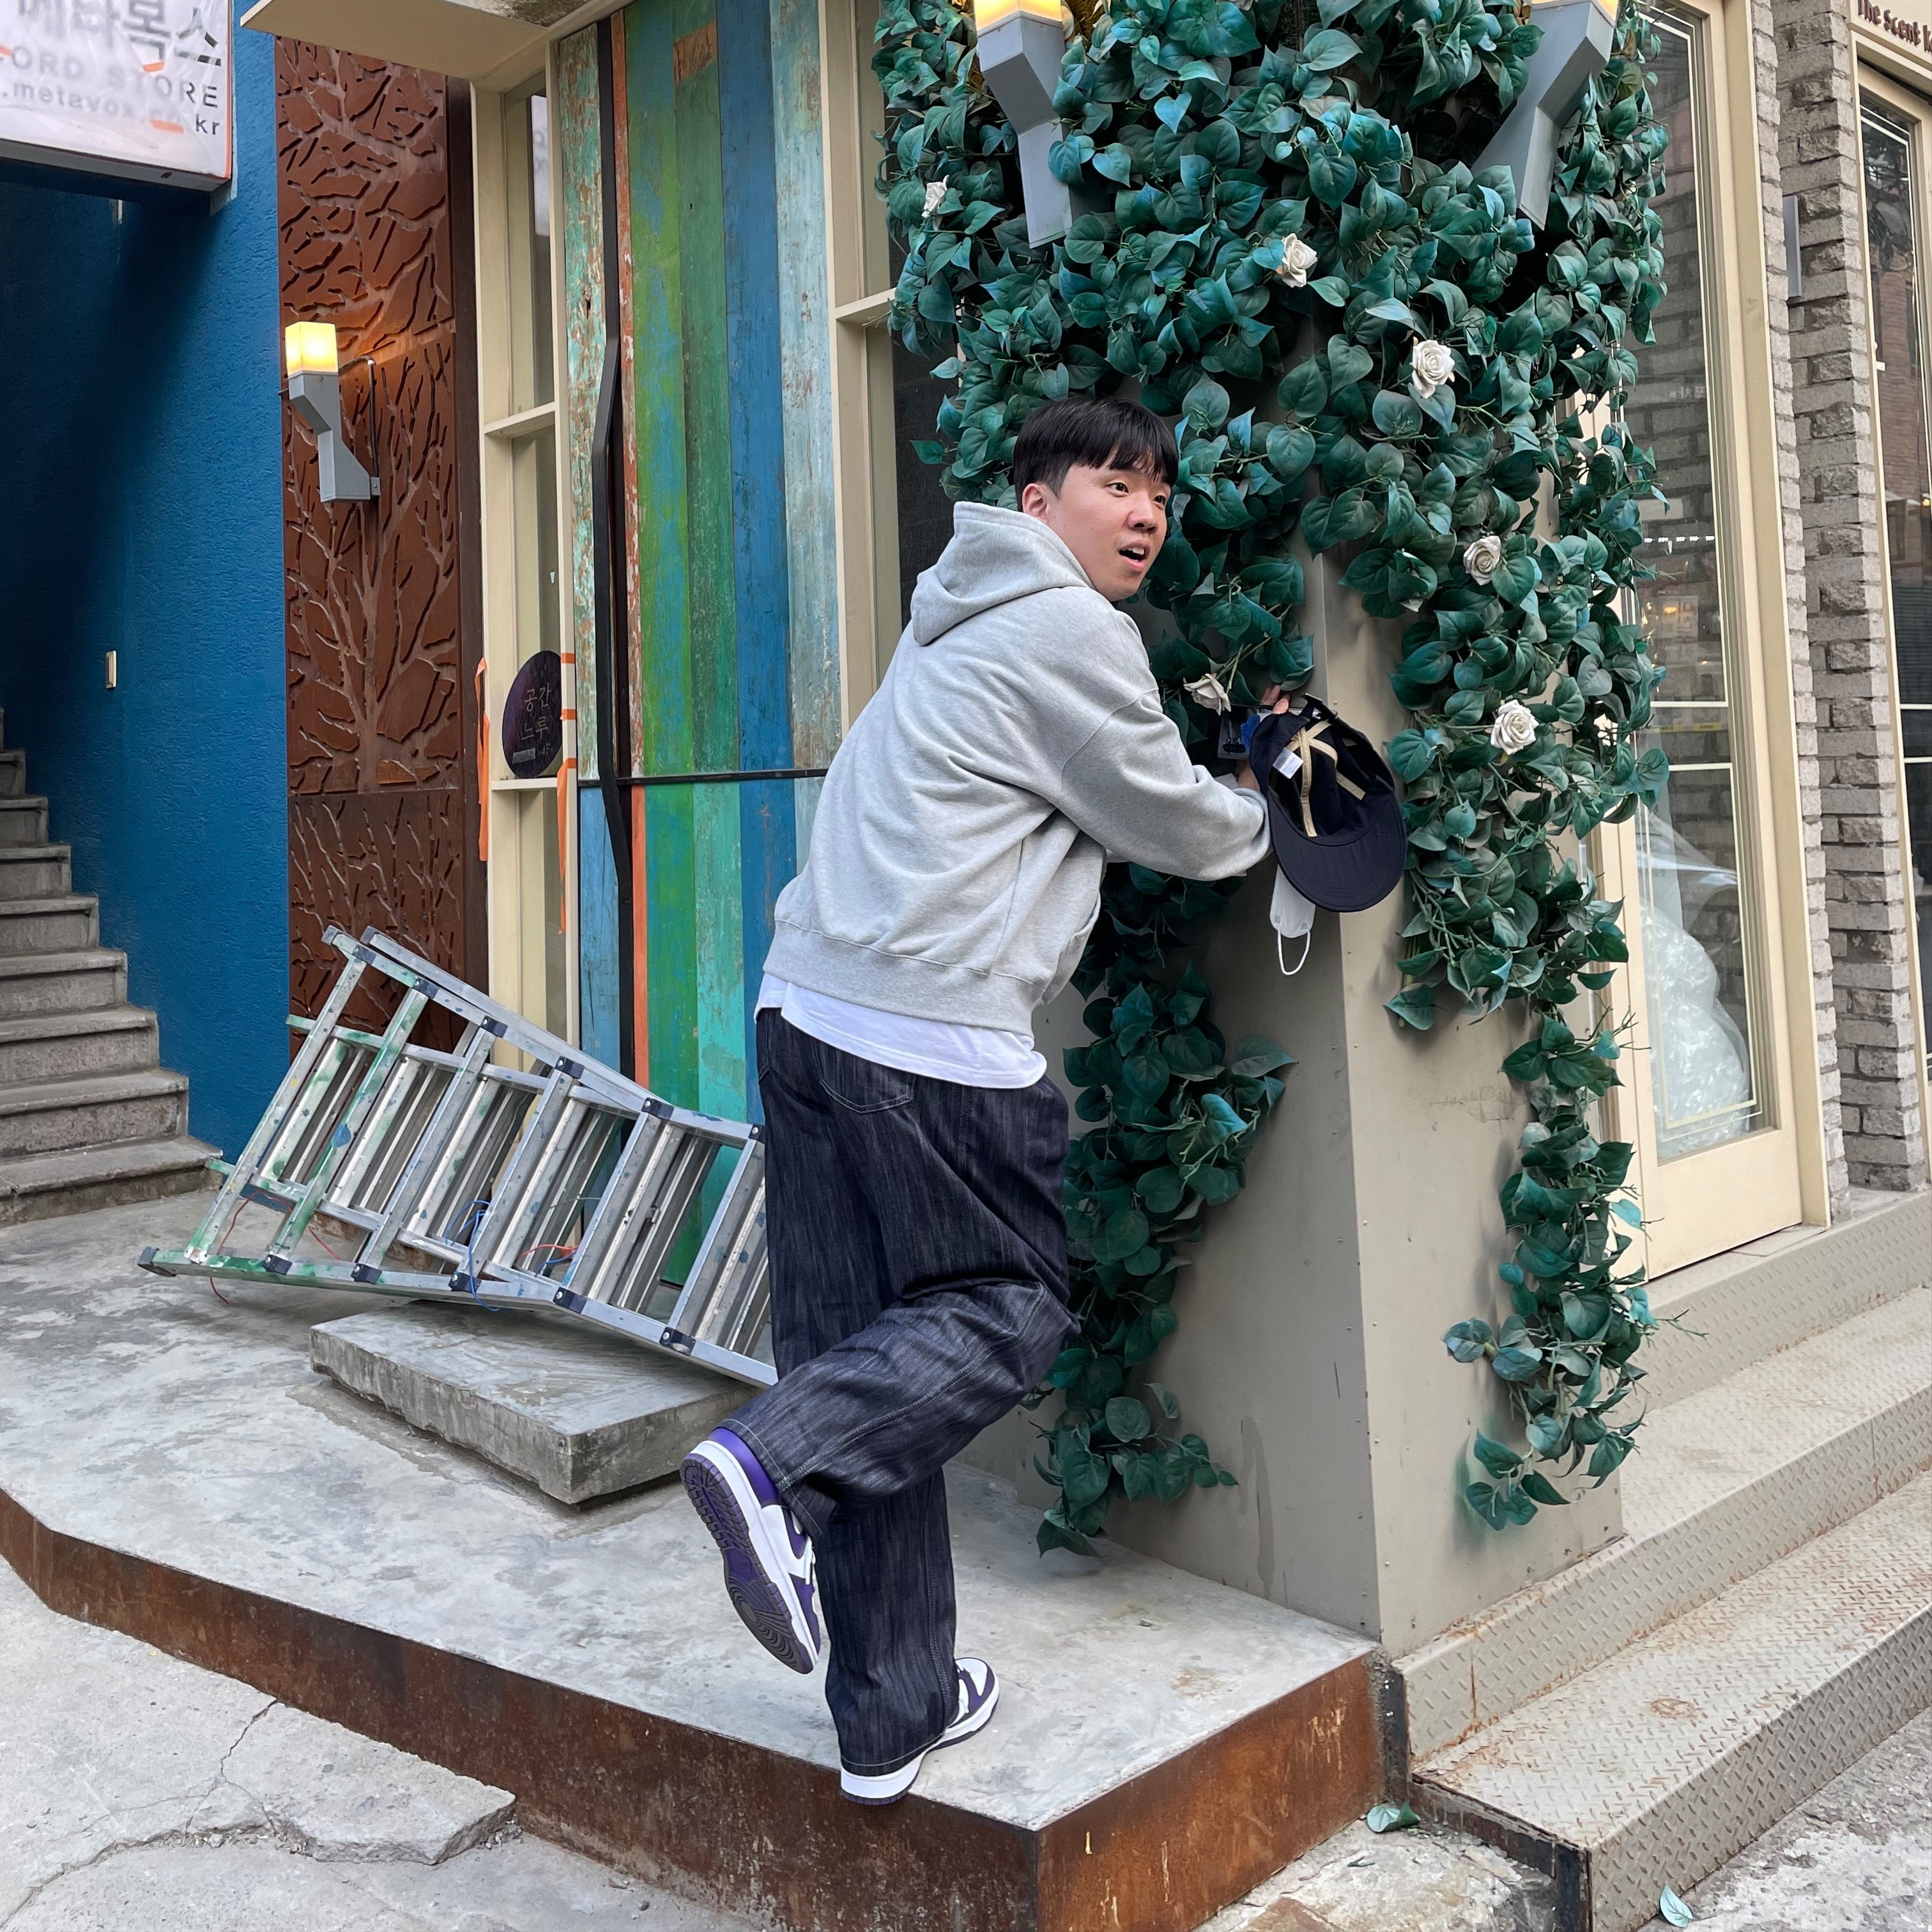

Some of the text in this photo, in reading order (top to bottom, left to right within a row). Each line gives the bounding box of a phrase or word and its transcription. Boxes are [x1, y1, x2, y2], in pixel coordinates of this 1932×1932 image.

[1883, 10, 1921, 46] Scent
[0, 46, 84, 79] ORD
[524, 681, 552, 712] 공간
